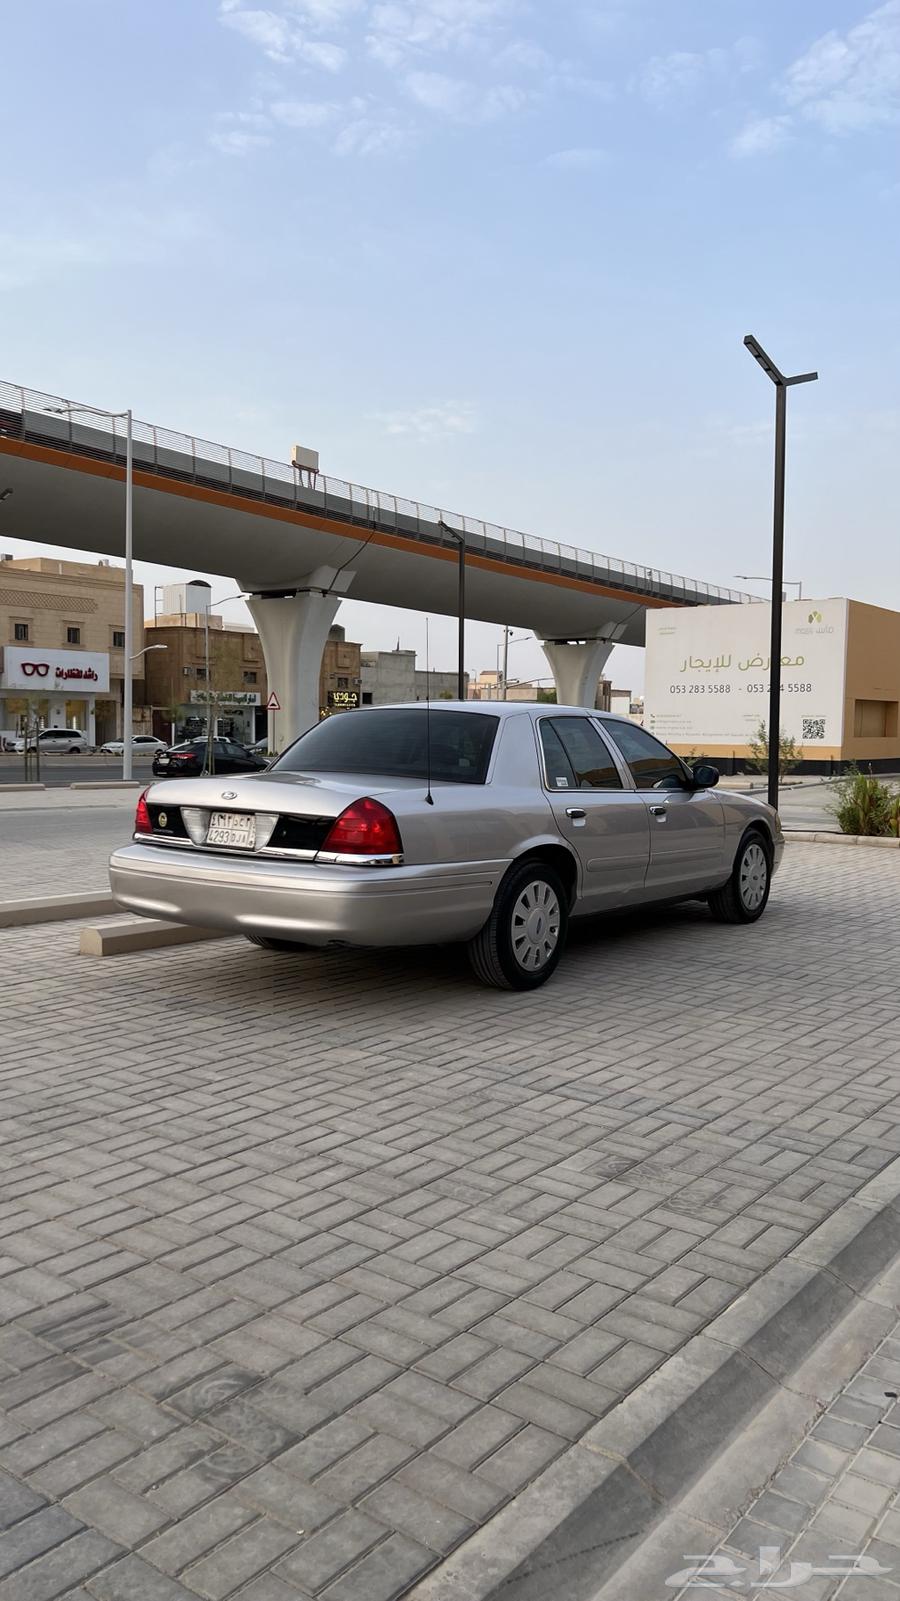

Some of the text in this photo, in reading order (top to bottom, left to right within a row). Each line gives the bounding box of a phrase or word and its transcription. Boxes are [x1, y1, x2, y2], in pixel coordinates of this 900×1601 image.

[680, 653, 805, 673] معرض للإيجار
[669, 684, 686, 694] 053
[689, 684, 705, 694] 283
[708, 684, 731, 694] 5588
[747, 684, 764, 693] 053
[766, 684, 785, 693] 24
[788, 683, 812, 693] 5588
[208, 830, 230, 844] 4293
